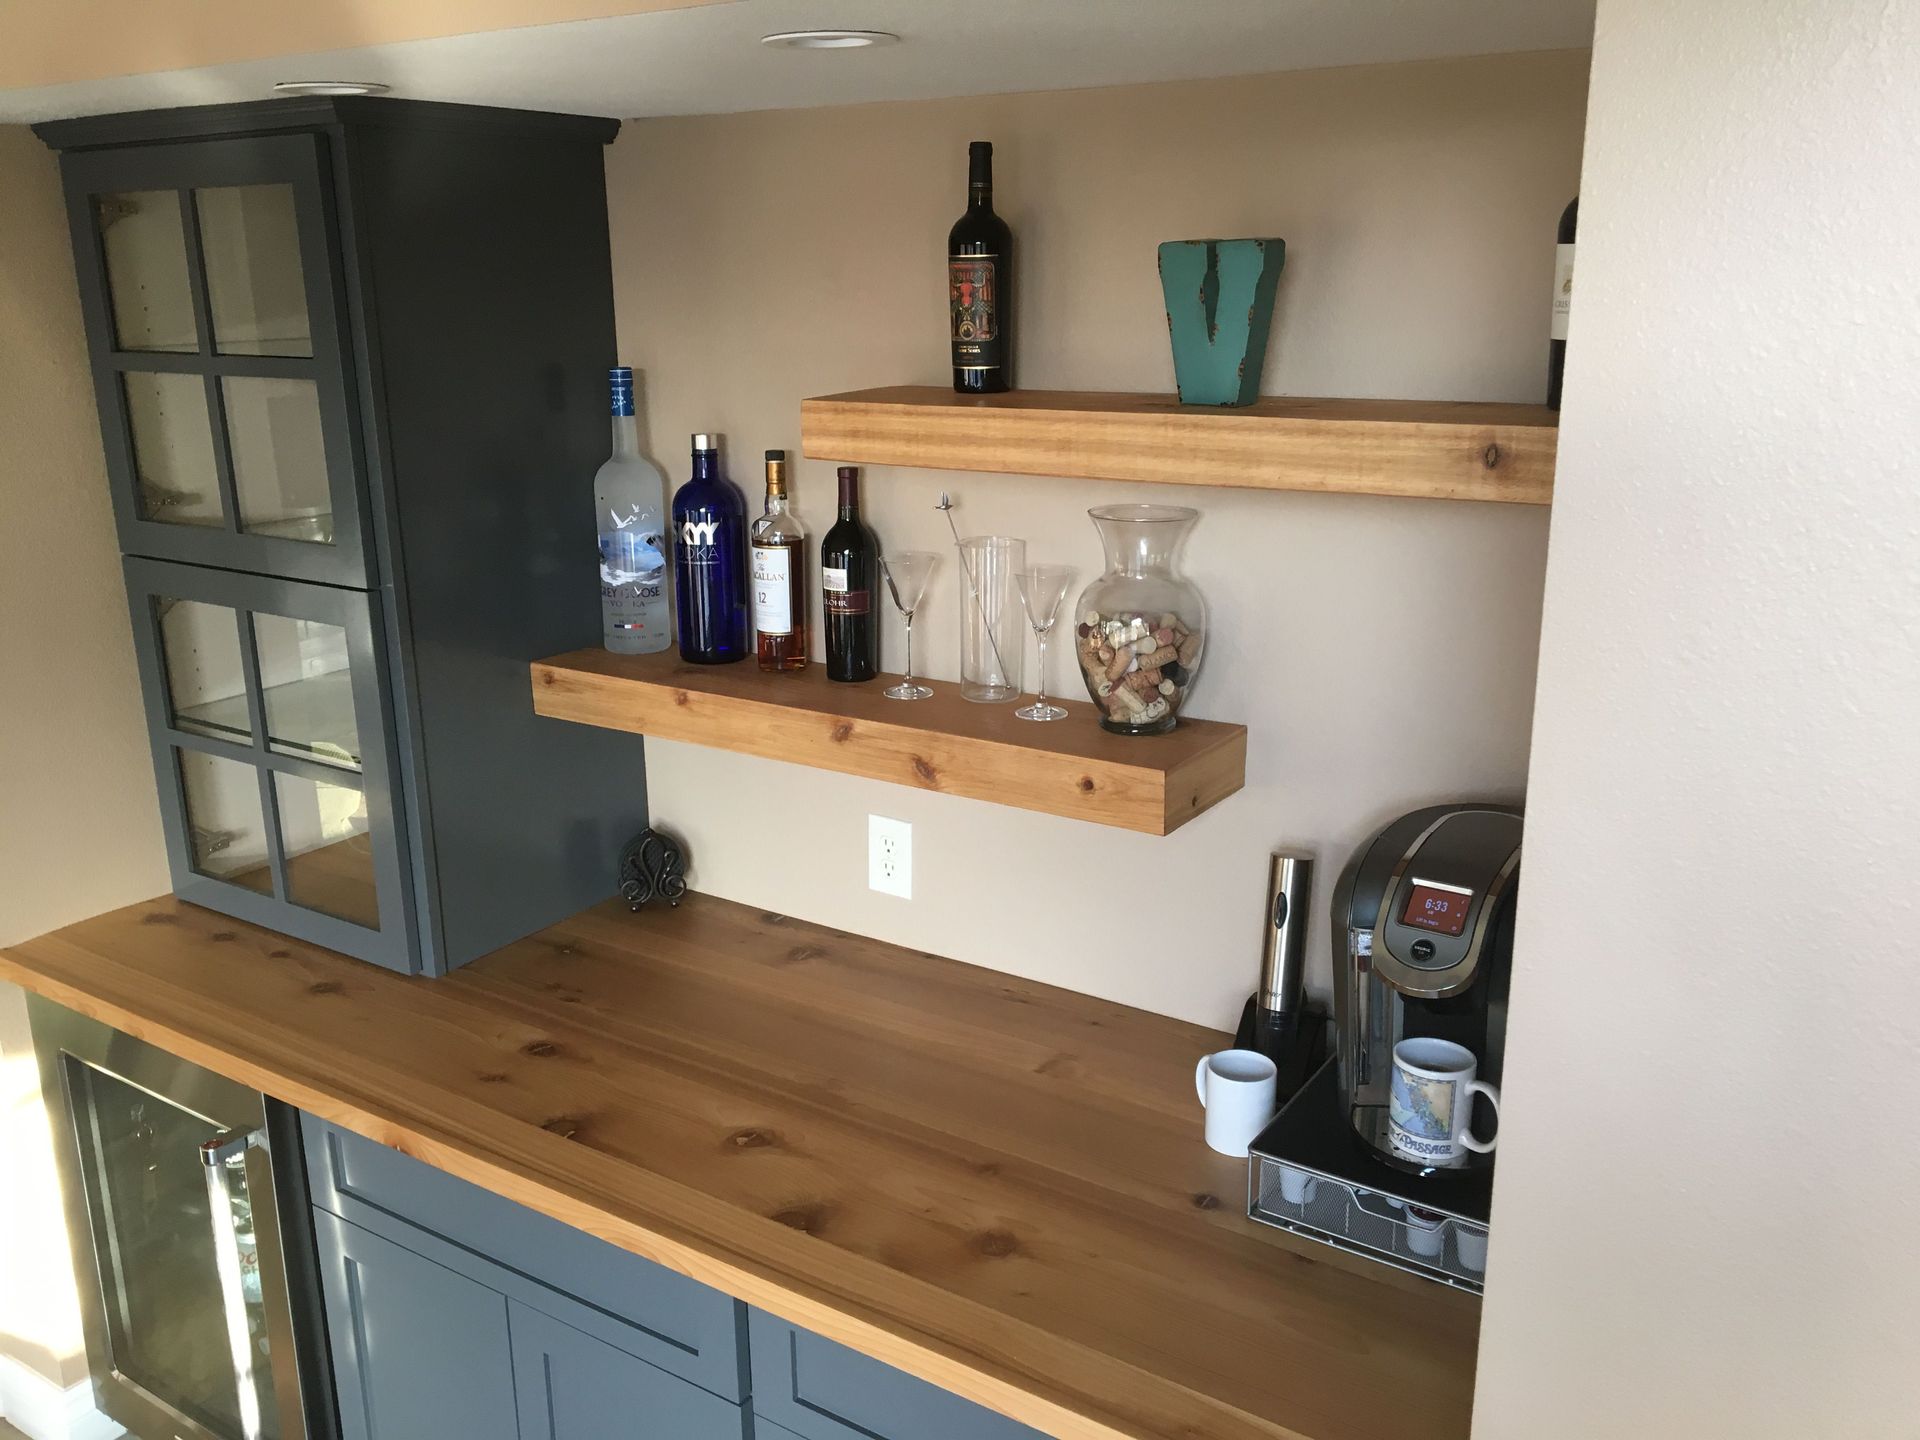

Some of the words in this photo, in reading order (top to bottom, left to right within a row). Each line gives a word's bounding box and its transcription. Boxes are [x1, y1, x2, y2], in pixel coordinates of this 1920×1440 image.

[752, 571, 785, 581] CALLAN
[758, 592, 767, 603] 12
[1425, 899, 1449, 912] 6:33
